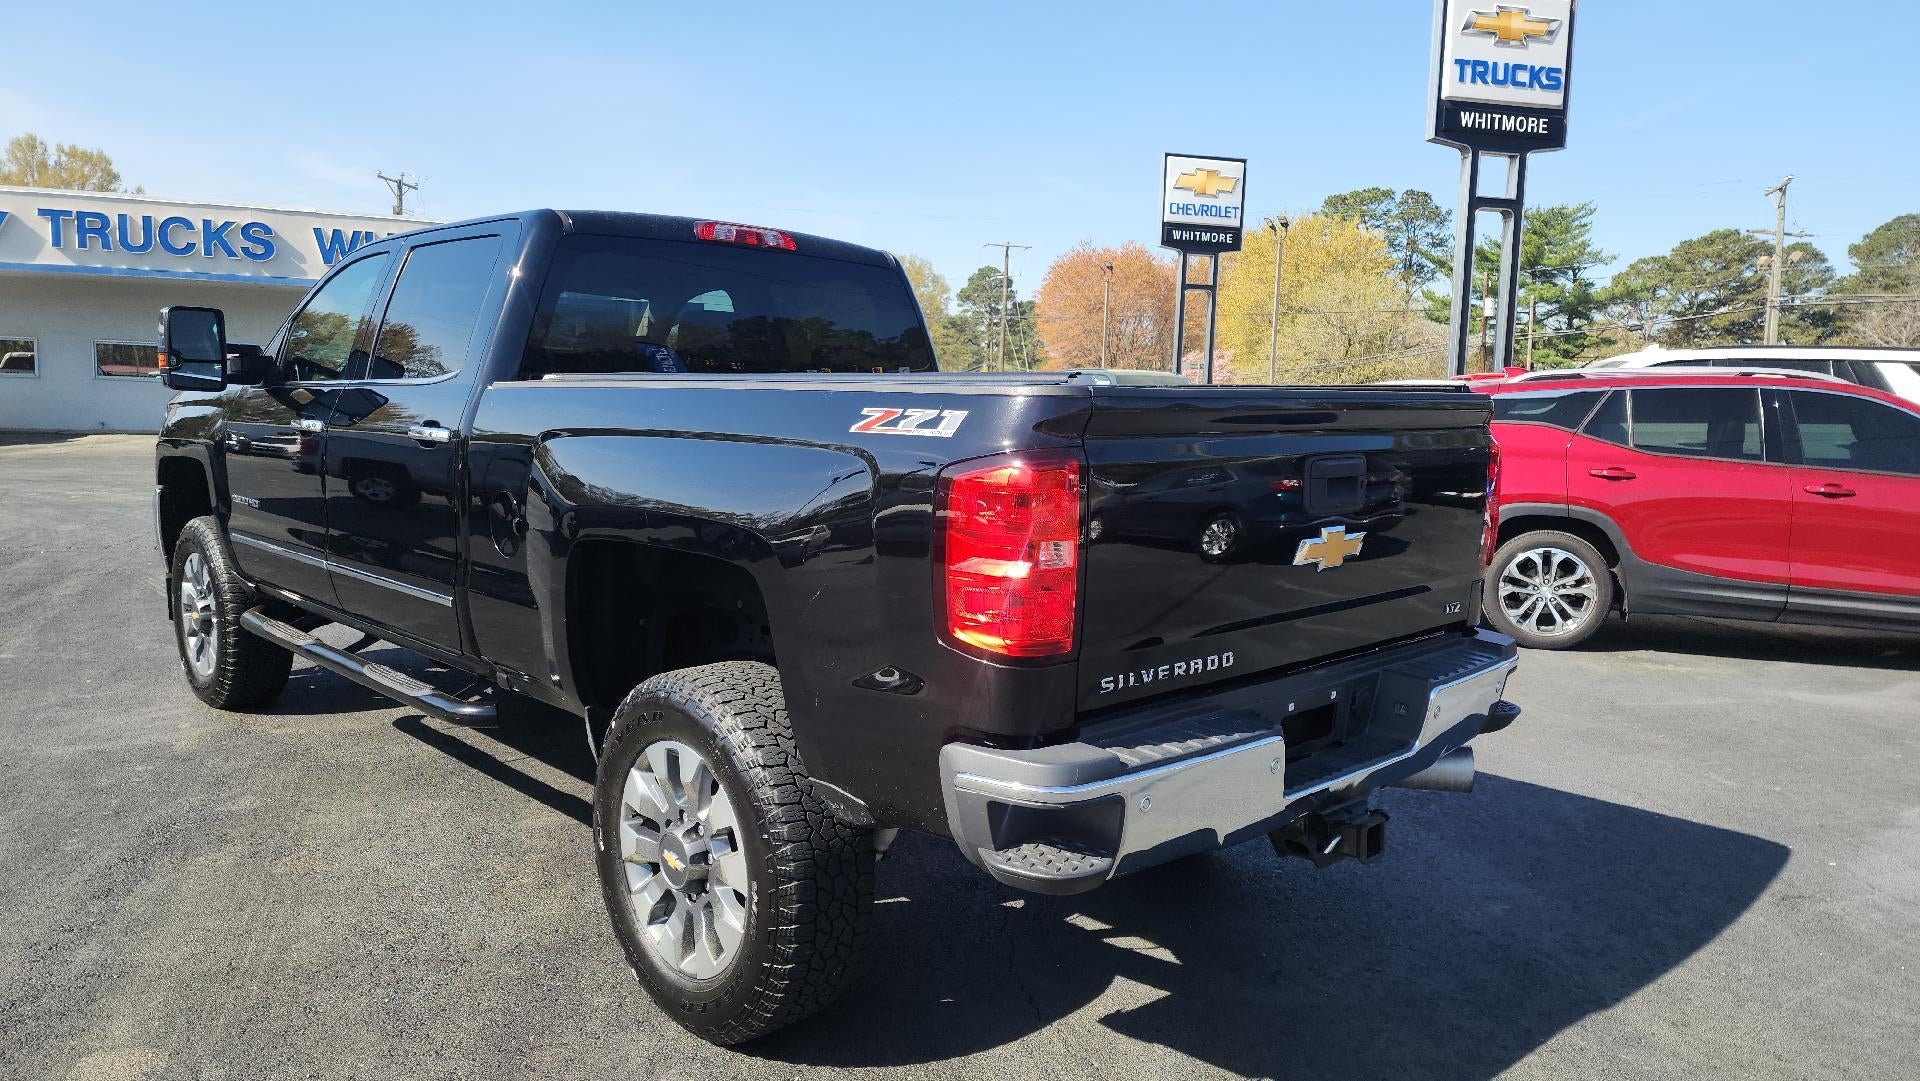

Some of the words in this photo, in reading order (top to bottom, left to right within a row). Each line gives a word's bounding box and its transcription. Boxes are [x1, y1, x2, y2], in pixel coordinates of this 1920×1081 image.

[1454, 58, 1562, 91] TRUCKS
[1460, 110, 1549, 134] WHITMORE
[1169, 202, 1239, 218] CHEVROLET
[37, 207, 277, 262] TRUCKS
[1172, 229, 1233, 243] WHITMORE
[848, 407, 969, 438] Z71
[1099, 651, 1236, 695] SILVERADO
